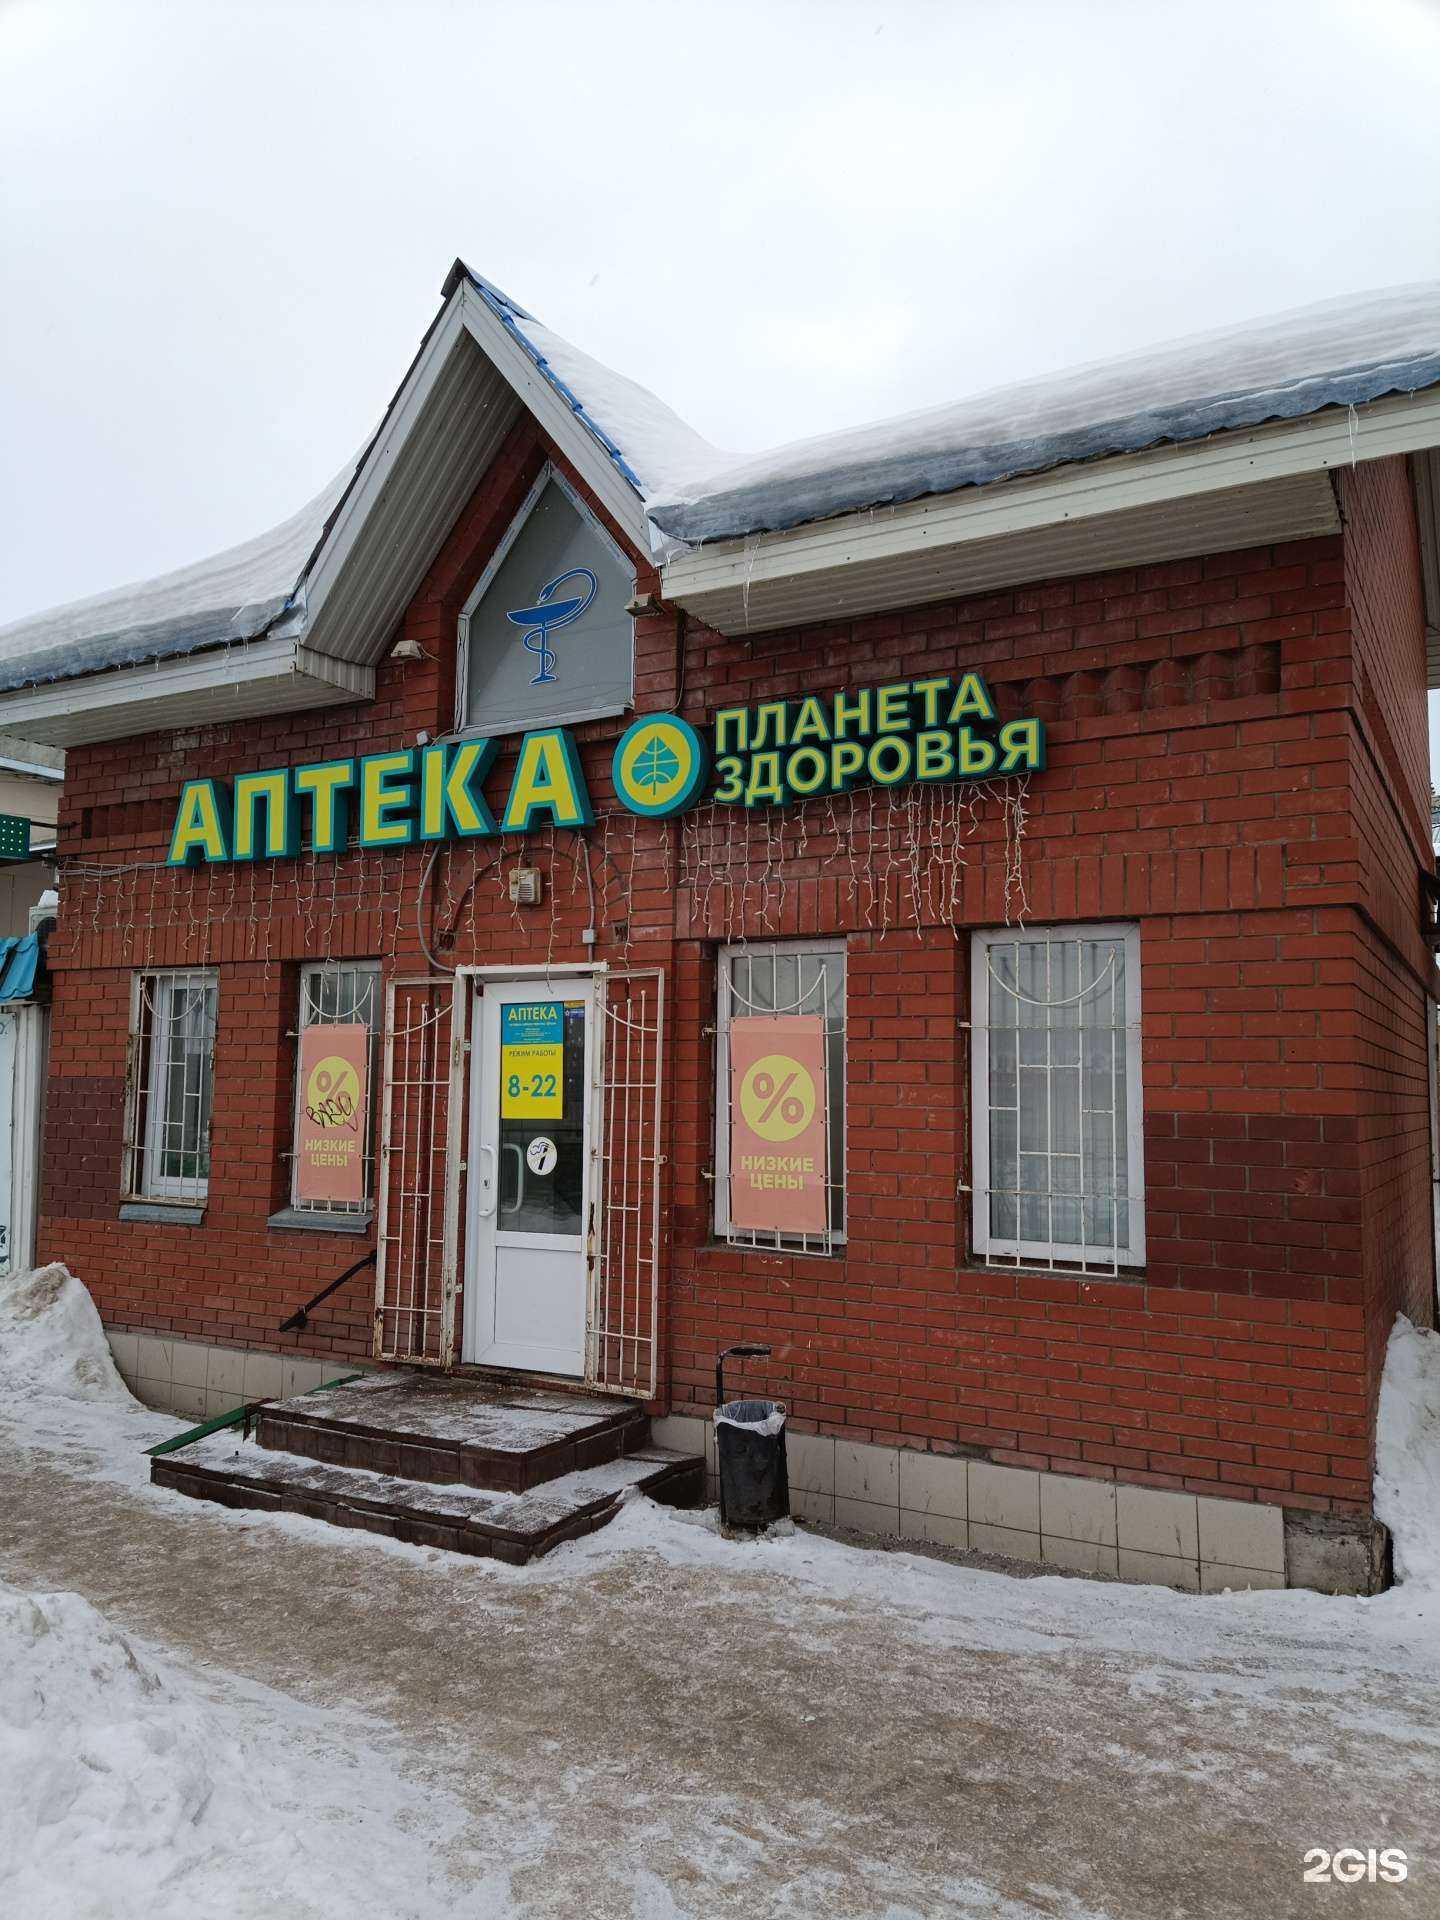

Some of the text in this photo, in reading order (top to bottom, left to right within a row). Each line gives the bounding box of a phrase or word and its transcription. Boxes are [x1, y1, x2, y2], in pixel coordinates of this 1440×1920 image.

[714, 672, 995, 755] ПЛАНЕТА
[714, 718, 1043, 807] ЗДОРОВЬЯ
[166, 728, 594, 866] АПТЕКА
[508, 1006, 557, 1021] АПТЕКА
[508, 1049, 557, 1057] РЕЖИМ РАБОТЫ
[508, 1074, 557, 1097] 8-22
[304, 1139, 356, 1152] НИЗКИЕ
[311, 1154, 348, 1168] ЦЕНЫ
[740, 1155, 815, 1173] НИЗКИЕ
[750, 1173, 805, 1191] ЦЕНЫ
